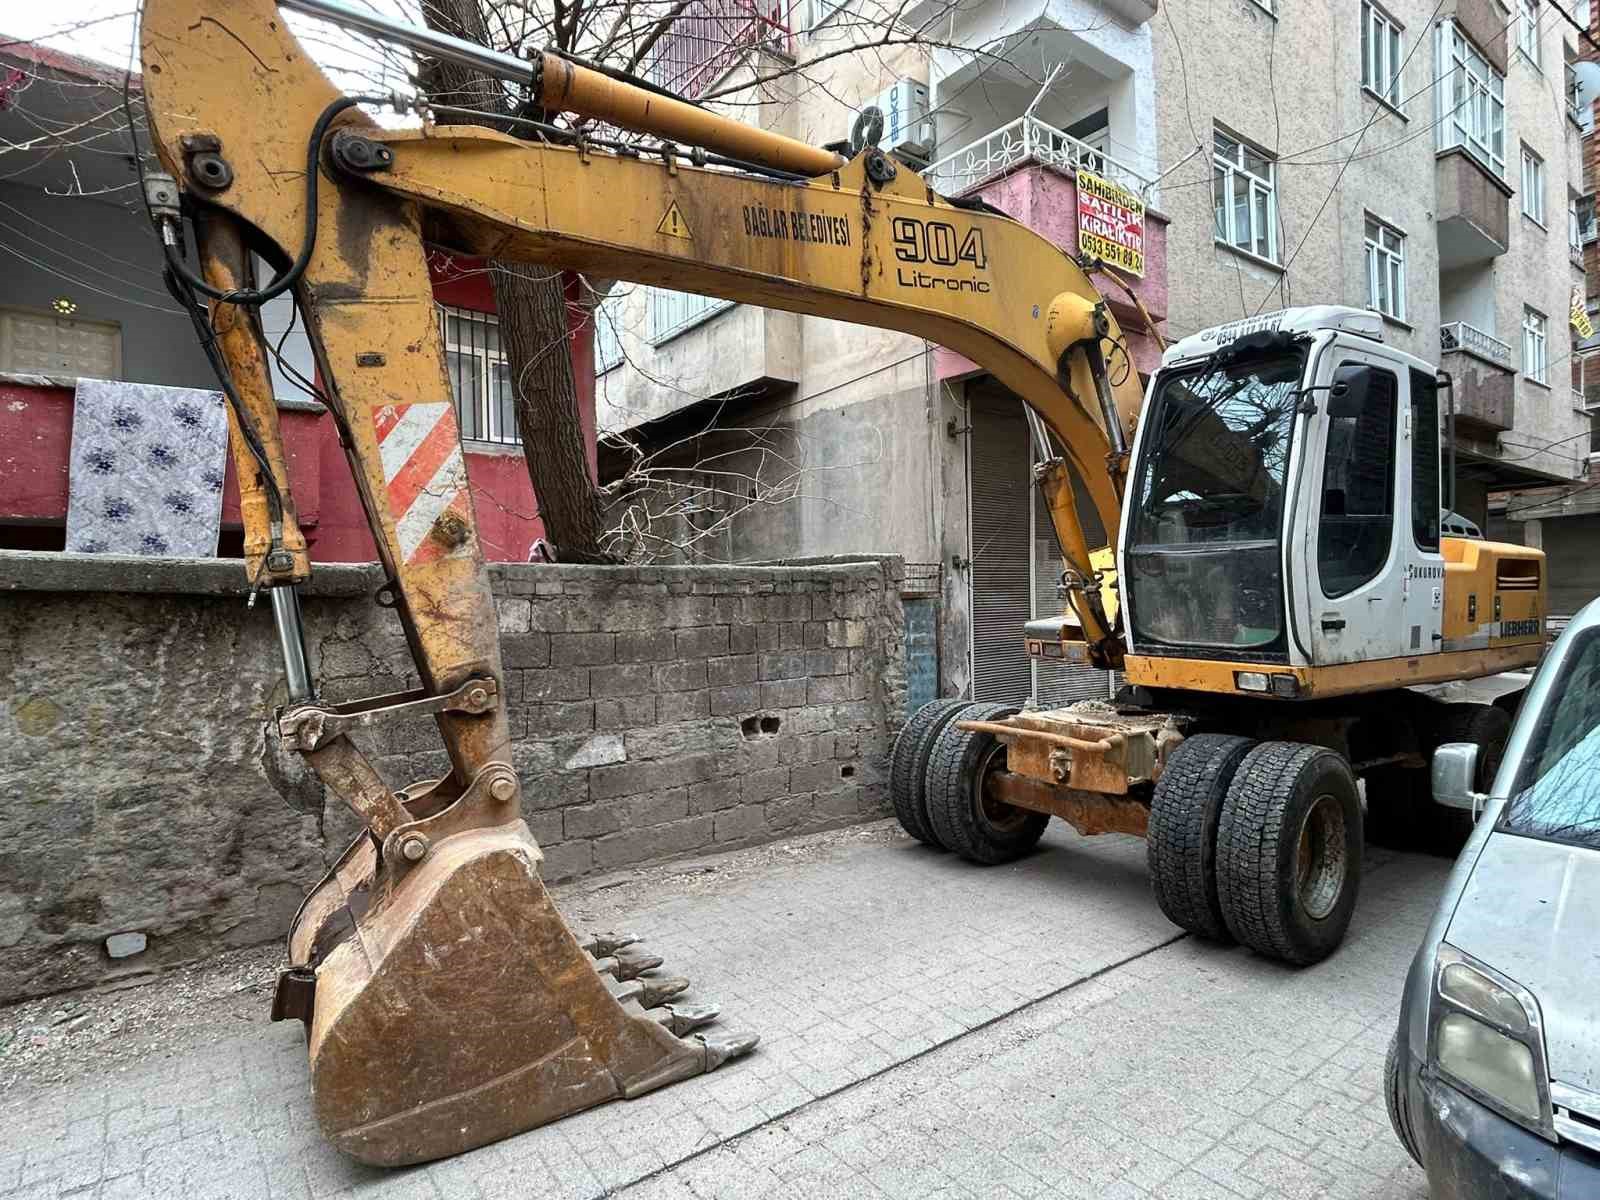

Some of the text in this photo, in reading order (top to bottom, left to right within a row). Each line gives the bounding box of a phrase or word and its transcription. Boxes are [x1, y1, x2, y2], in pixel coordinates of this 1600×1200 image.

[1080, 193, 1142, 225] SATILIK
[743, 202, 851, 247] BAĞLAR BELEDİYESİ
[892, 217, 987, 269] 904
[1081, 233, 1103, 255] 0533
[897, 268, 990, 293] Litronic
[1500, 620, 1540, 639] LIEBHERR
